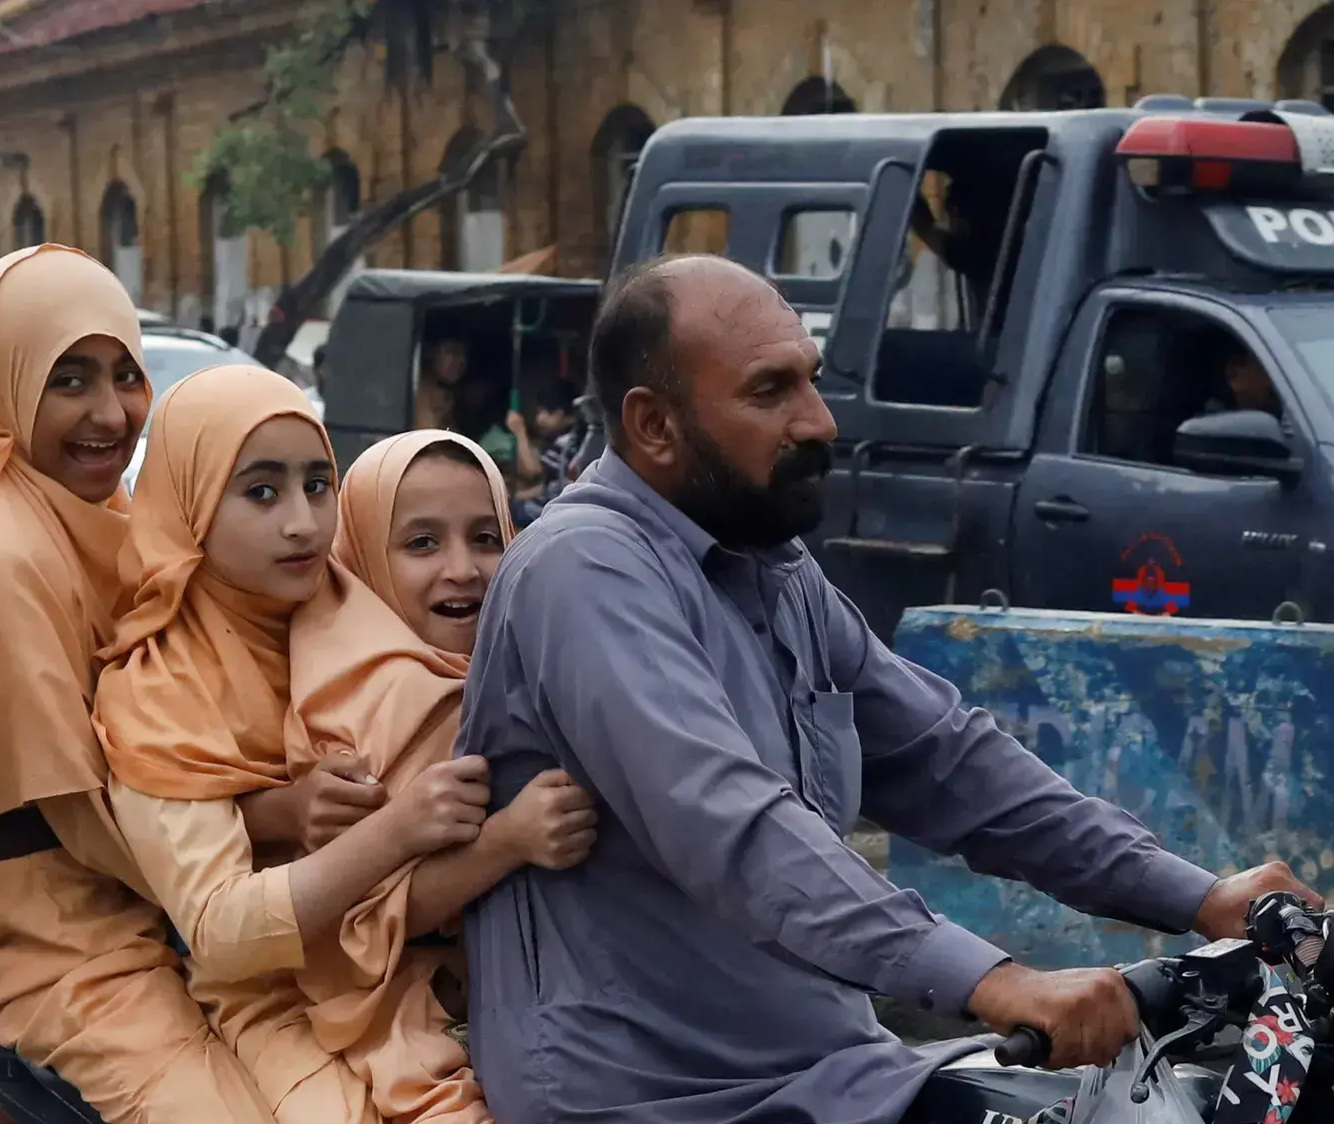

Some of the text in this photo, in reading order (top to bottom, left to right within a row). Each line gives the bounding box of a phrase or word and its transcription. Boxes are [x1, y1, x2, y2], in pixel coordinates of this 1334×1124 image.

[1270, 1002, 1304, 1032] R
[1242, 1023, 1278, 1060] O
[1243, 1063, 1282, 1106] Y
